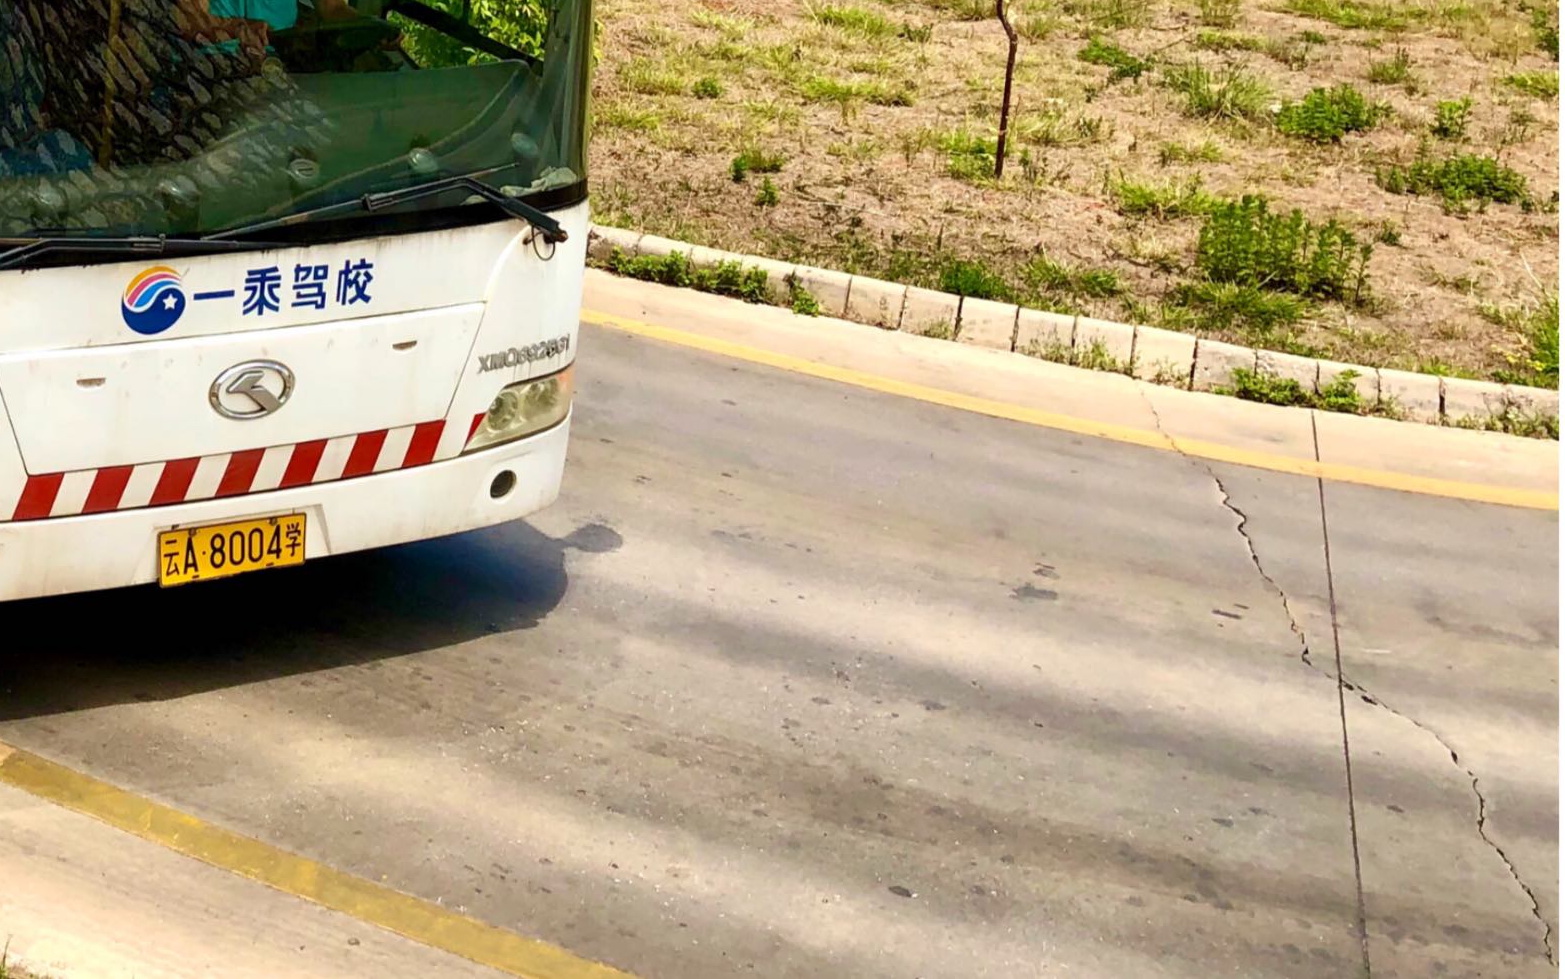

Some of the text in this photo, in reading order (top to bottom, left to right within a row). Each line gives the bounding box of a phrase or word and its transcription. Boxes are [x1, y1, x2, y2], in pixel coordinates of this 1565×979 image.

[193, 258, 374, 316] 一乘驾校
[163, 522, 302, 578] 云A·8004学
